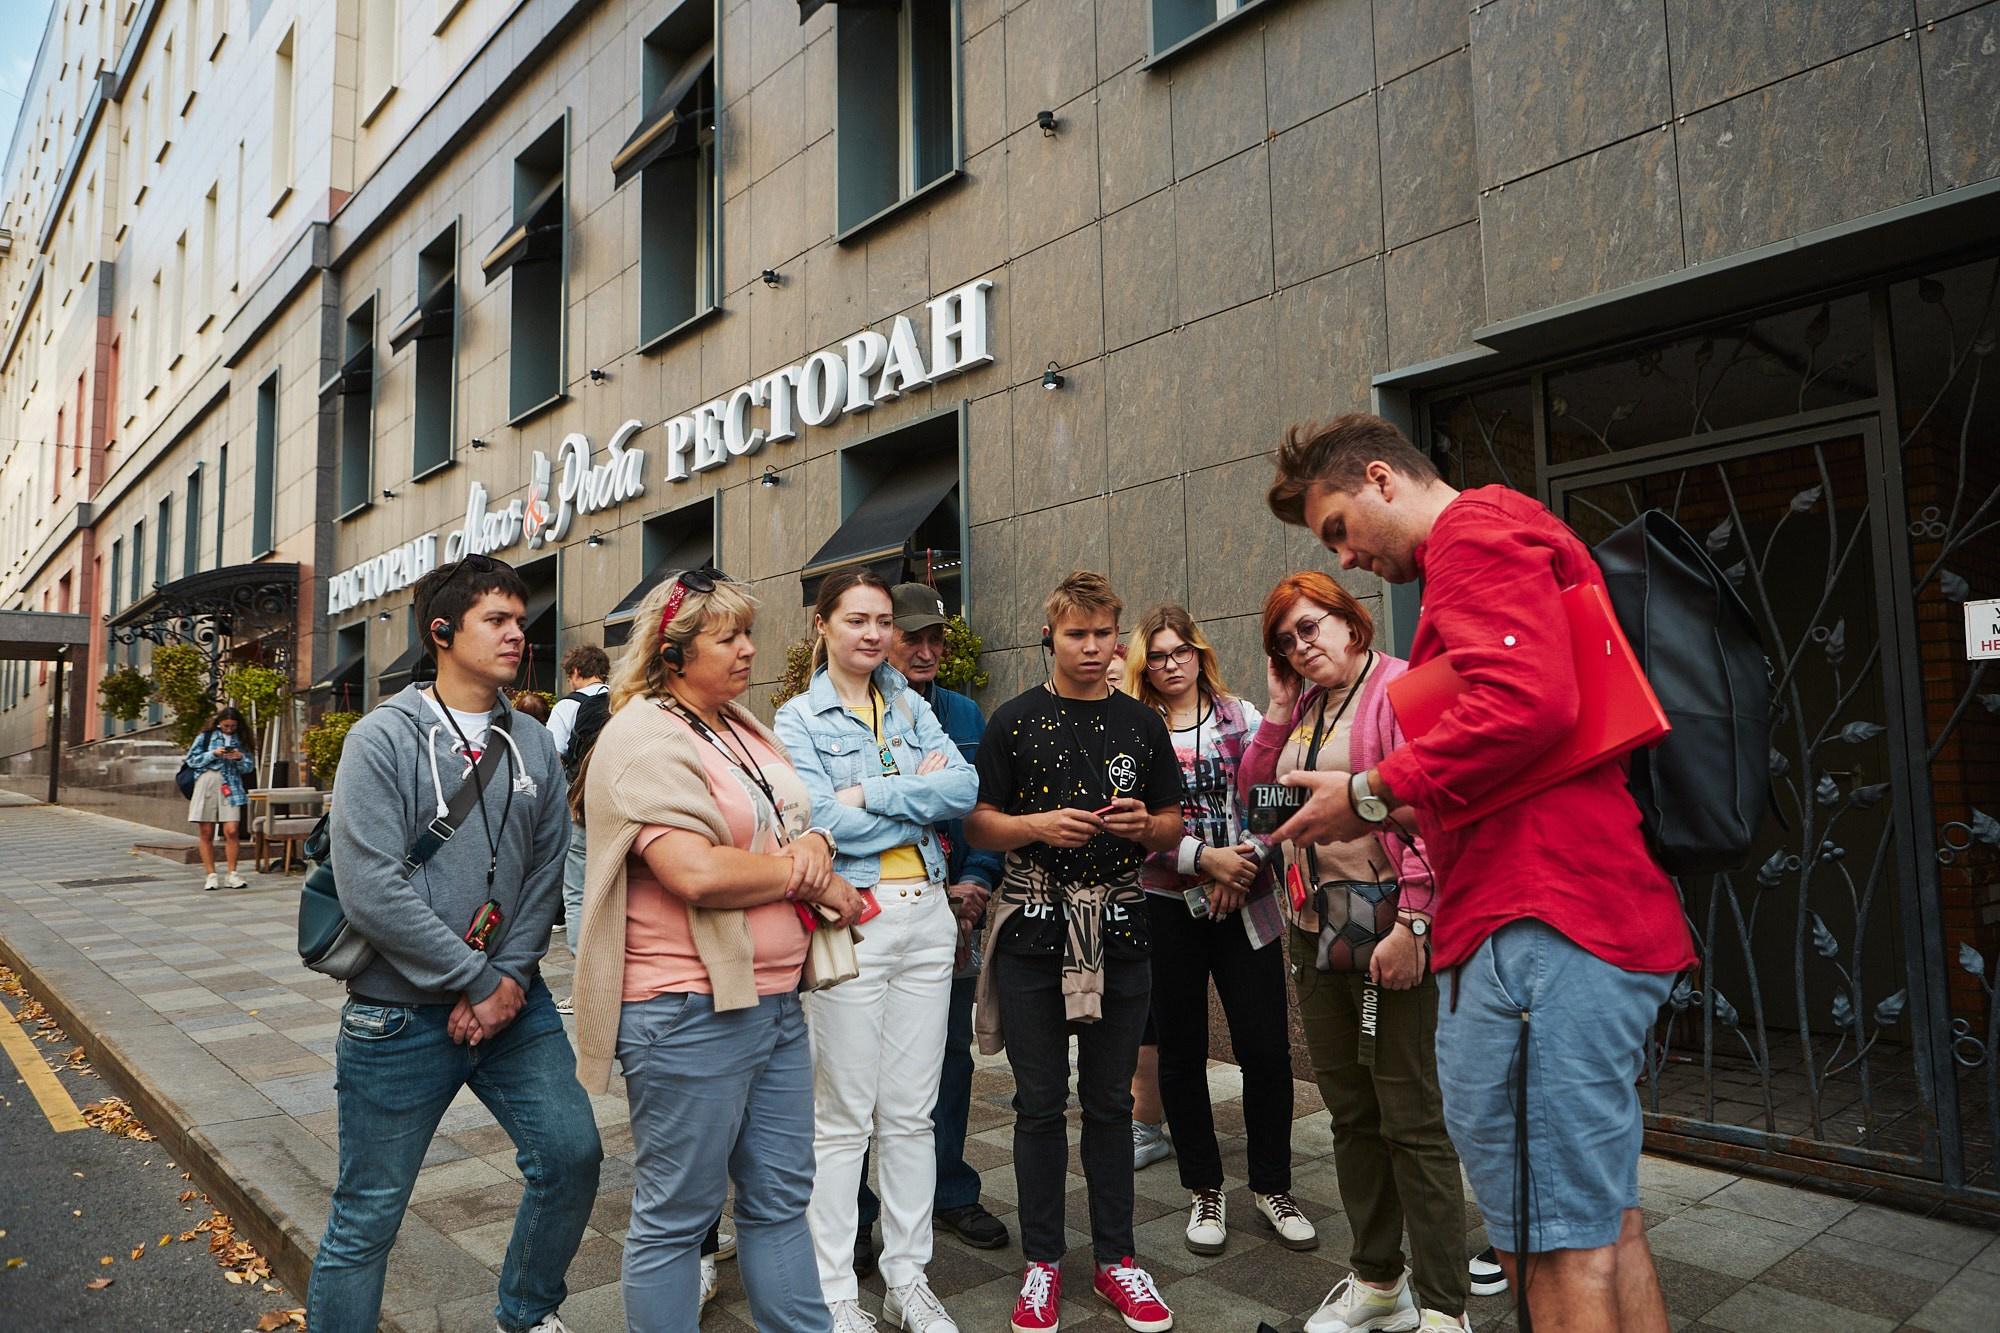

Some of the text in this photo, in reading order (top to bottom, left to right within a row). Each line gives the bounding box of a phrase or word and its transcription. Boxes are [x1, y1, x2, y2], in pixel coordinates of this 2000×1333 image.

[327, 533, 438, 615] РЕСТОРАН
[545, 419, 645, 542] Рыба
[664, 279, 993, 483] РЕСТОРАН
[1255, 787, 1301, 807] TRAVEL
